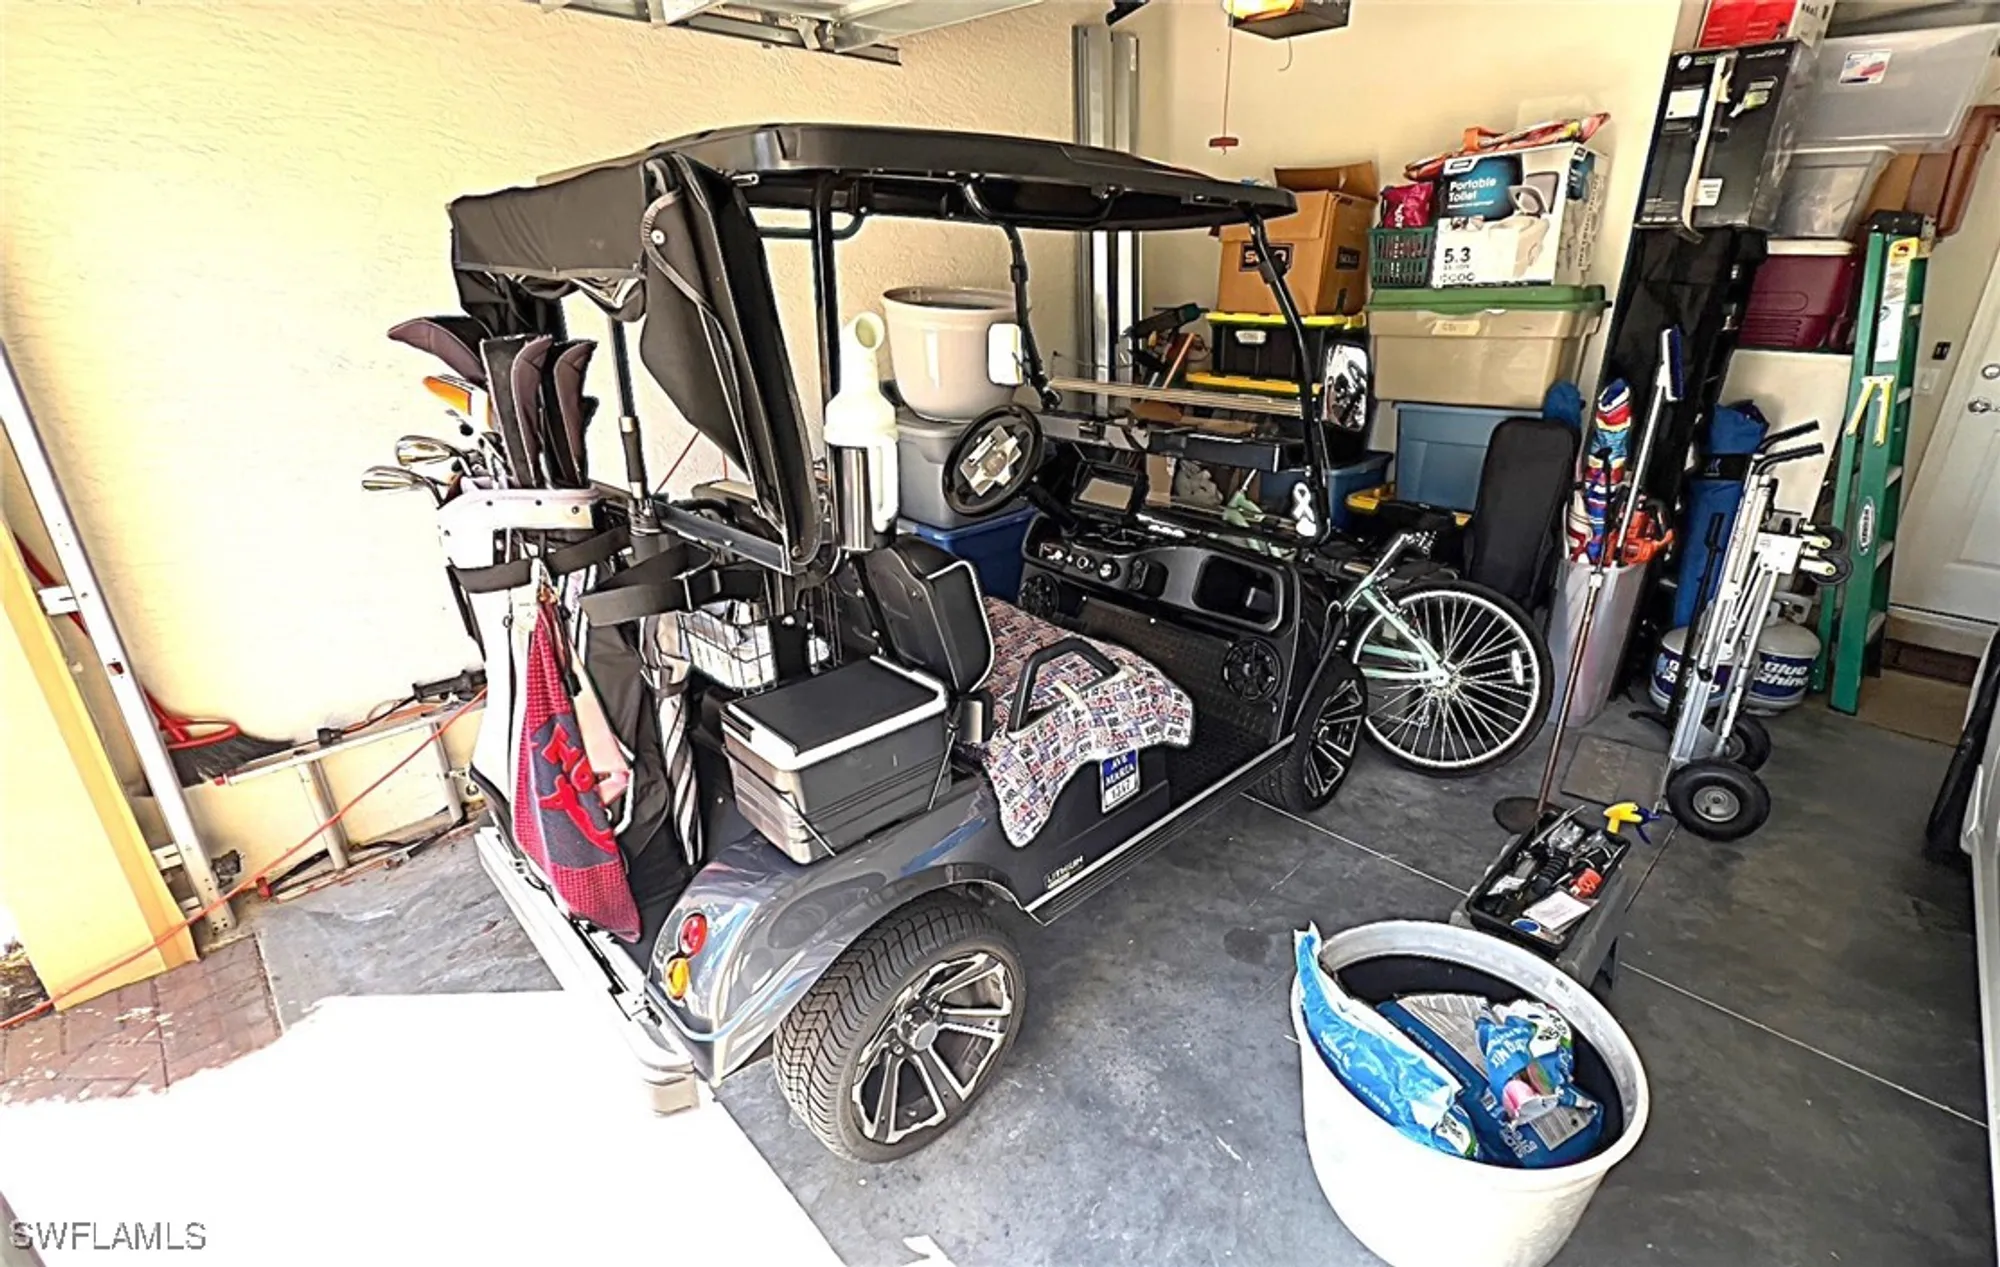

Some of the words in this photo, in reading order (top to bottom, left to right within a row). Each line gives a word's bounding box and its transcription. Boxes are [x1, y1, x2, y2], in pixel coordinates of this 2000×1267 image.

[1450, 176, 1497, 191] Portable
[1449, 190, 1477, 202] Toilet
[1444, 246, 1471, 263] 5.3
[1764, 661, 1808, 676] Blue
